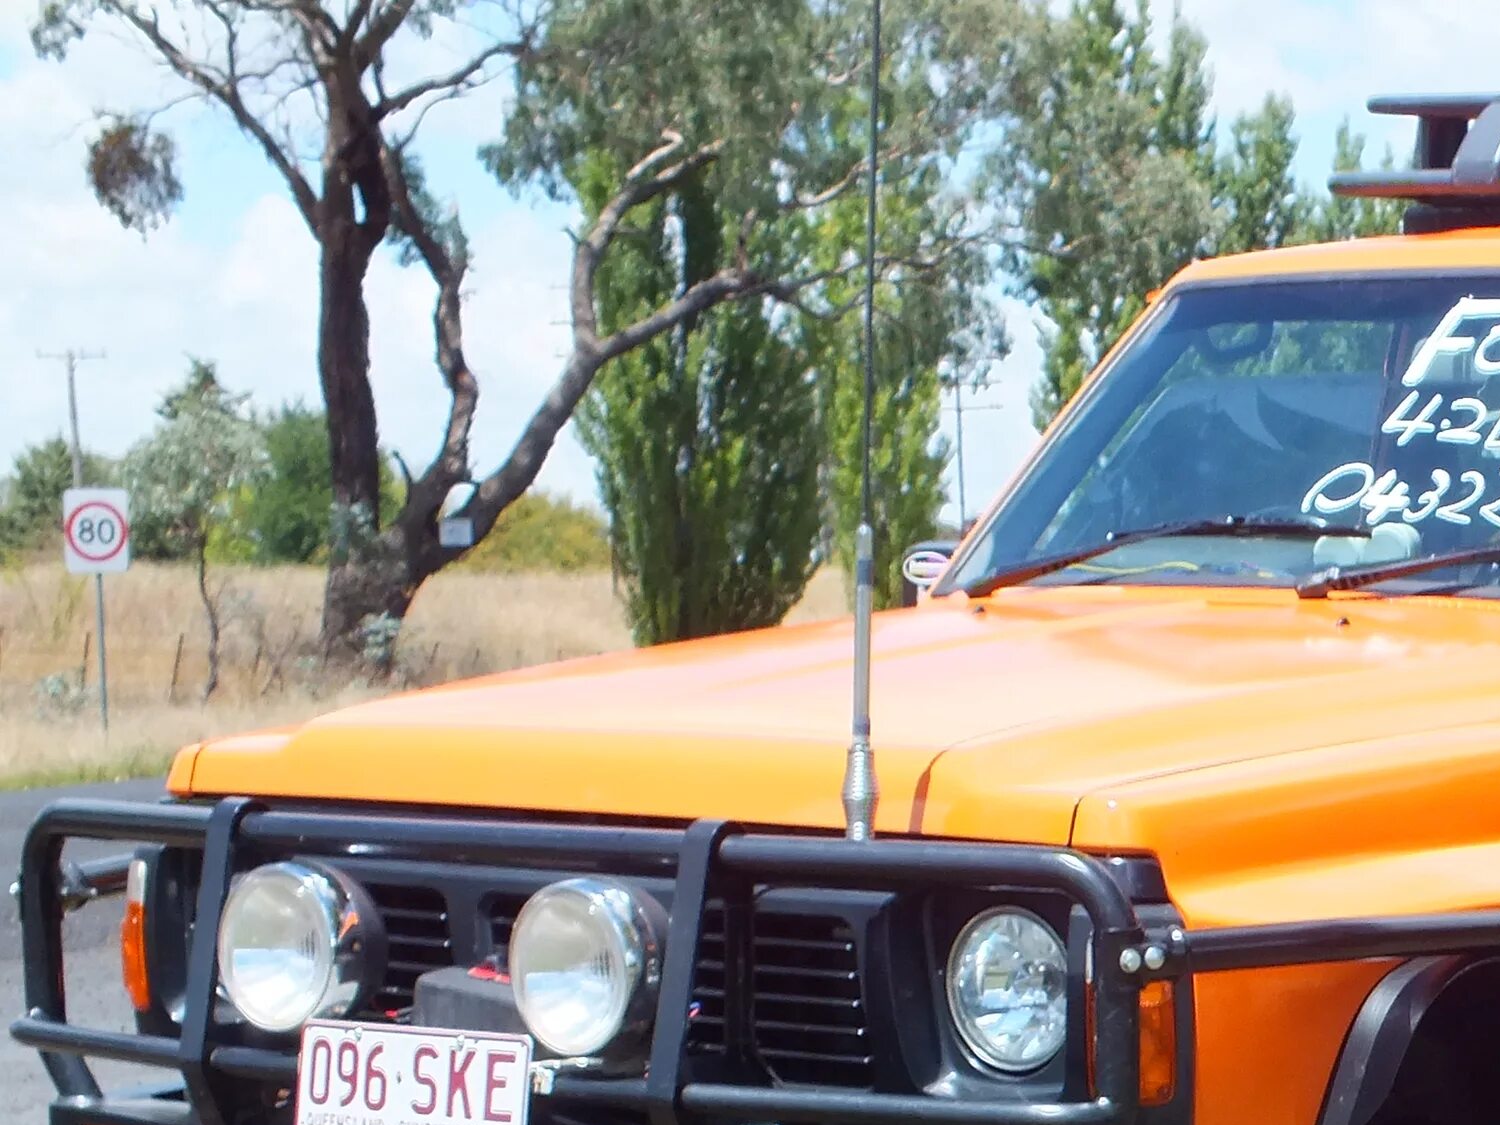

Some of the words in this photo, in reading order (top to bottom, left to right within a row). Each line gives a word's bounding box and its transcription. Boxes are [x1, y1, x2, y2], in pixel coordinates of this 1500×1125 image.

[78, 518, 115, 545] 80
[308, 1036, 388, 1111] 096
[411, 1043, 517, 1123] SKE
